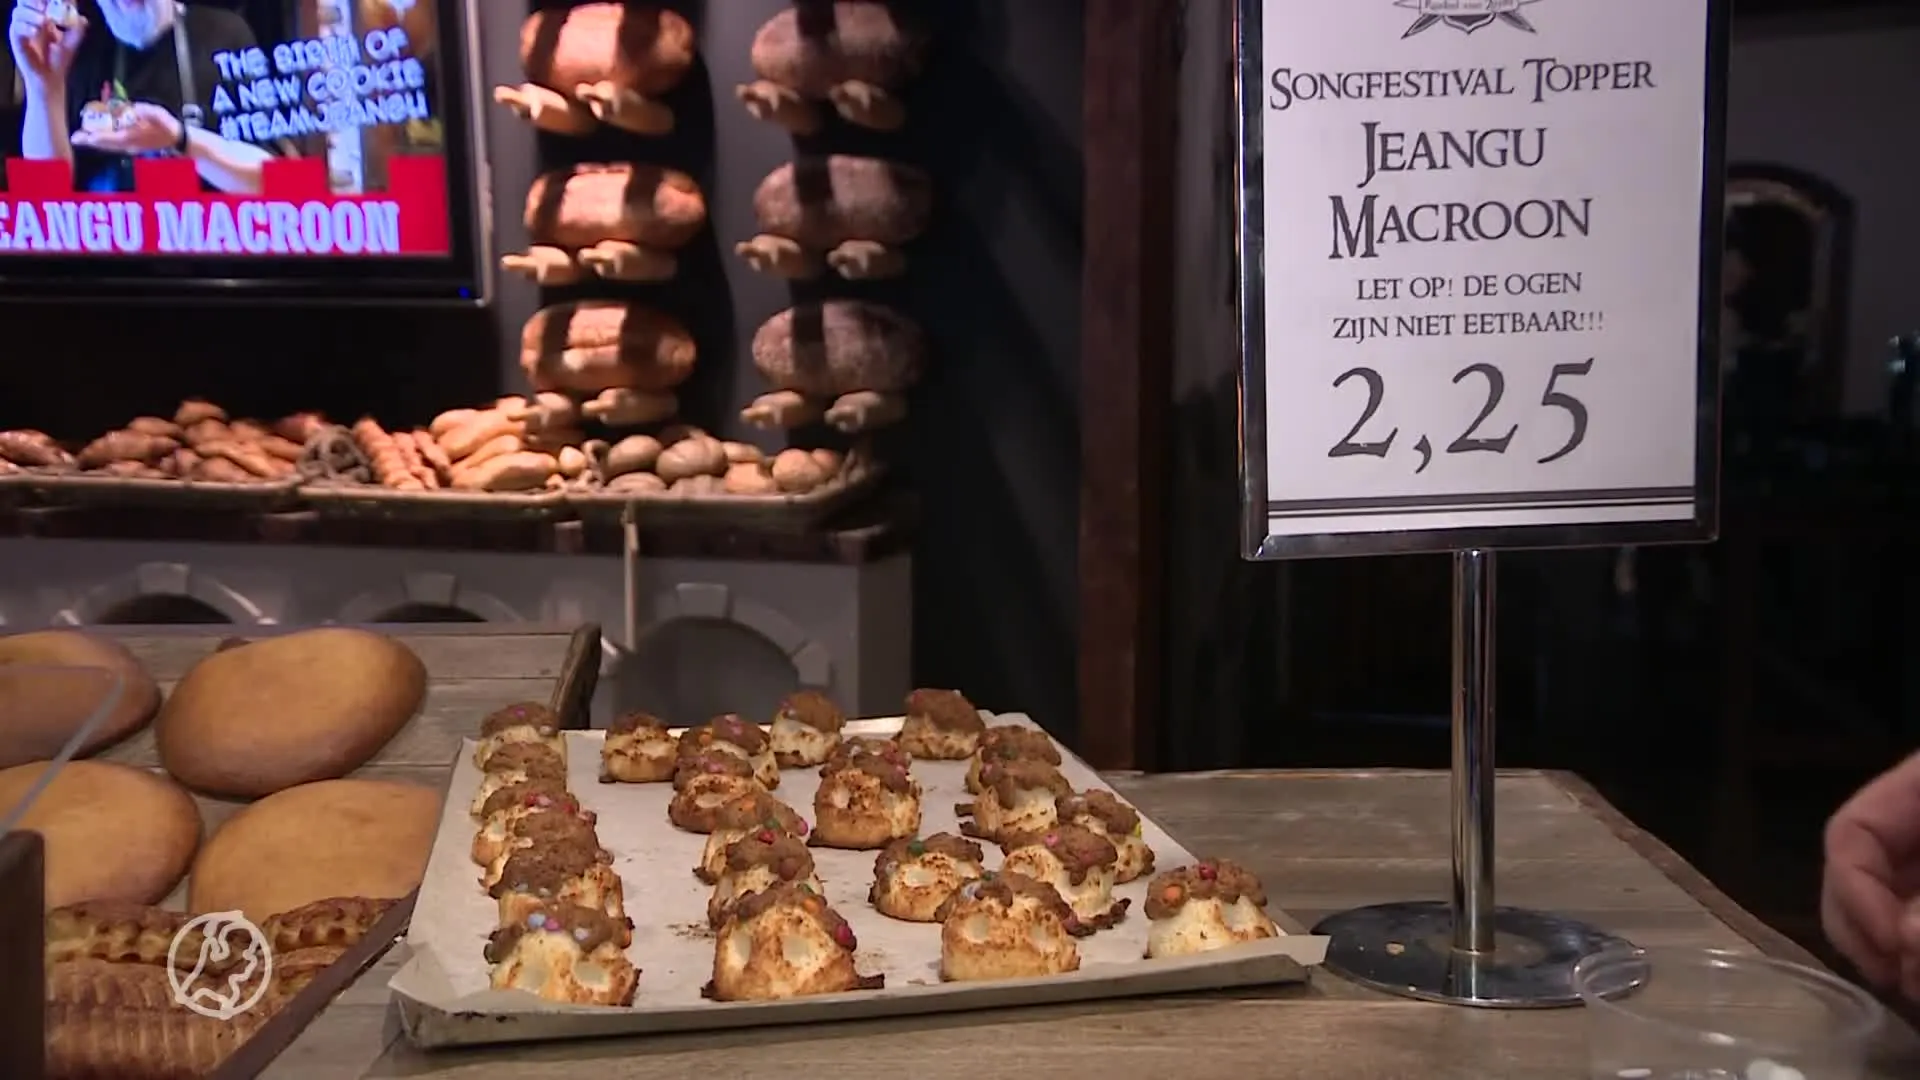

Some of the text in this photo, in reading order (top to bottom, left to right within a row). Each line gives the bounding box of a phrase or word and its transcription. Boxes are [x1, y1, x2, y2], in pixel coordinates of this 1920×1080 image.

[212, 57, 425, 111] A NEW COOKIE
[1270, 57, 1657, 110] SONGFESTIVAL TOPPER
[1356, 120, 1547, 189] JEANGU
[154, 200, 399, 252] MACROON
[1328, 194, 1593, 260] MACROON
[1357, 271, 1583, 300] LET OP! DE OGEN
[1332, 310, 1604, 344] ZIJN NIET EETBAAR!!!
[1328, 358, 1595, 474] 2,25
